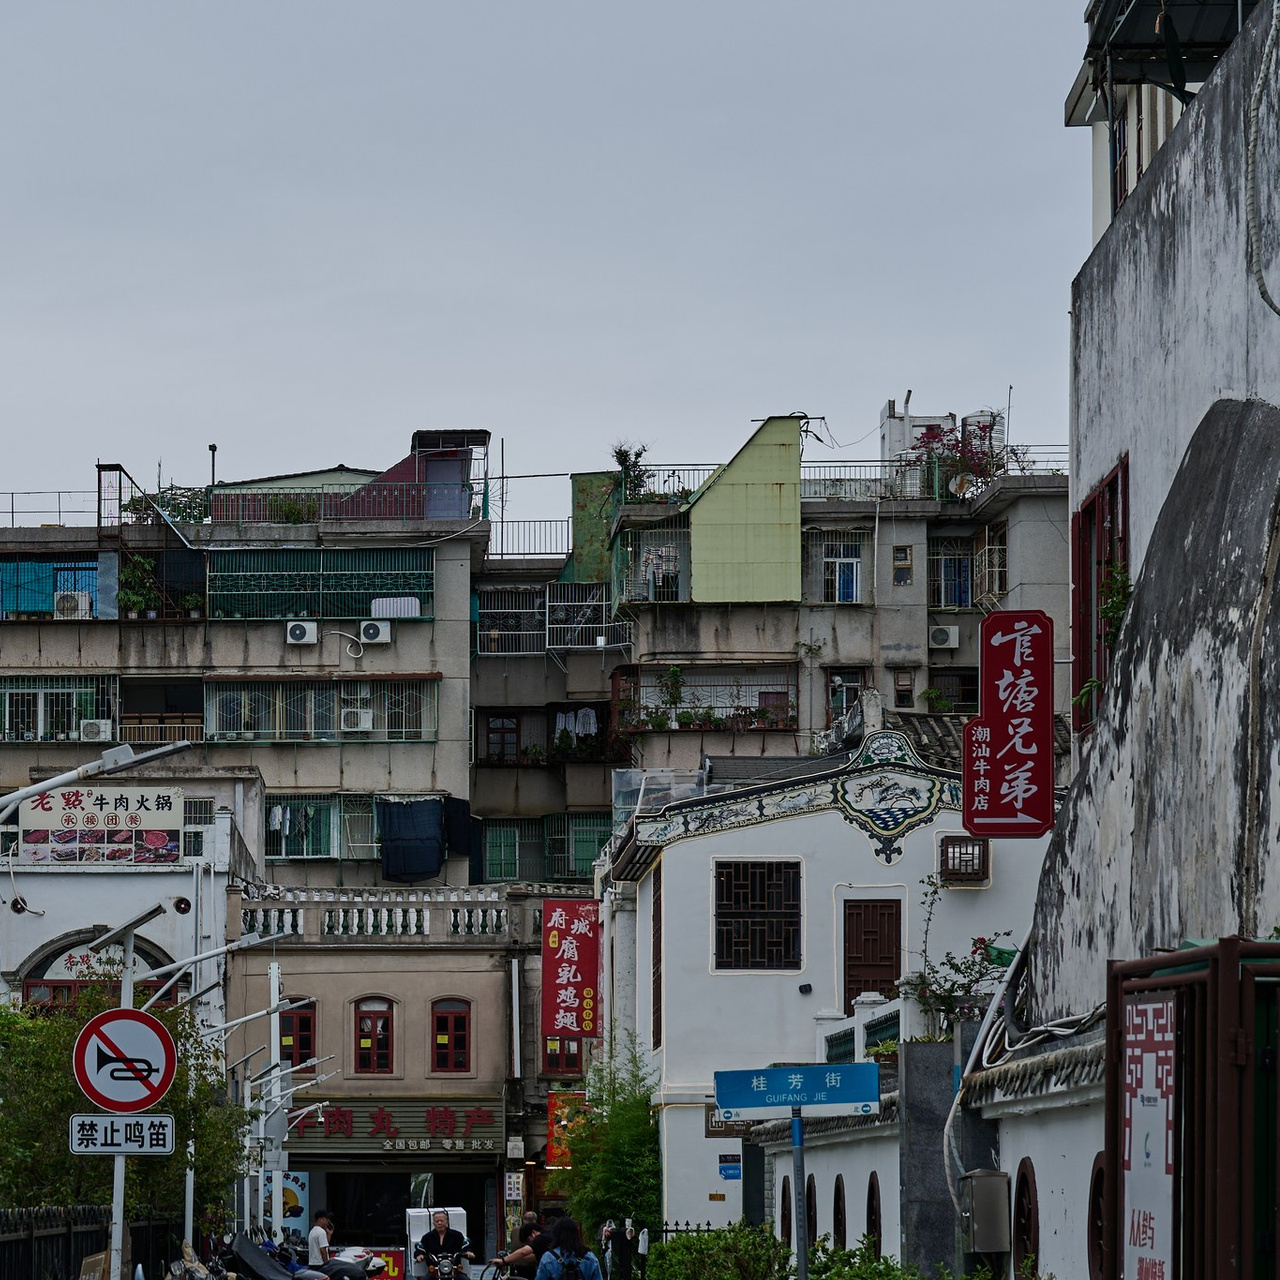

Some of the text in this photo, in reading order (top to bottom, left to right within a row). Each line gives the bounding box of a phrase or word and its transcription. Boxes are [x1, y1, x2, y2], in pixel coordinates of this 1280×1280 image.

[990, 620, 1043, 810] 官塘兄弟
[971, 726, 991, 811] 潮汕牛肉店
[92, 793, 173, 812] 牛肉火锅
[62, 814, 141, 828] 承接团餐
[555, 936, 582, 1031] 腐乳鸡翅
[751, 1072, 842, 1092] 桂芳街
[765, 1092, 827, 1104] GUIFANG JIE
[425, 1106, 495, 1138] 特产
[77, 1121, 168, 1149] 禁止鸣笛
[383, 1139, 495, 1150] 全国包邮 零售 批发
